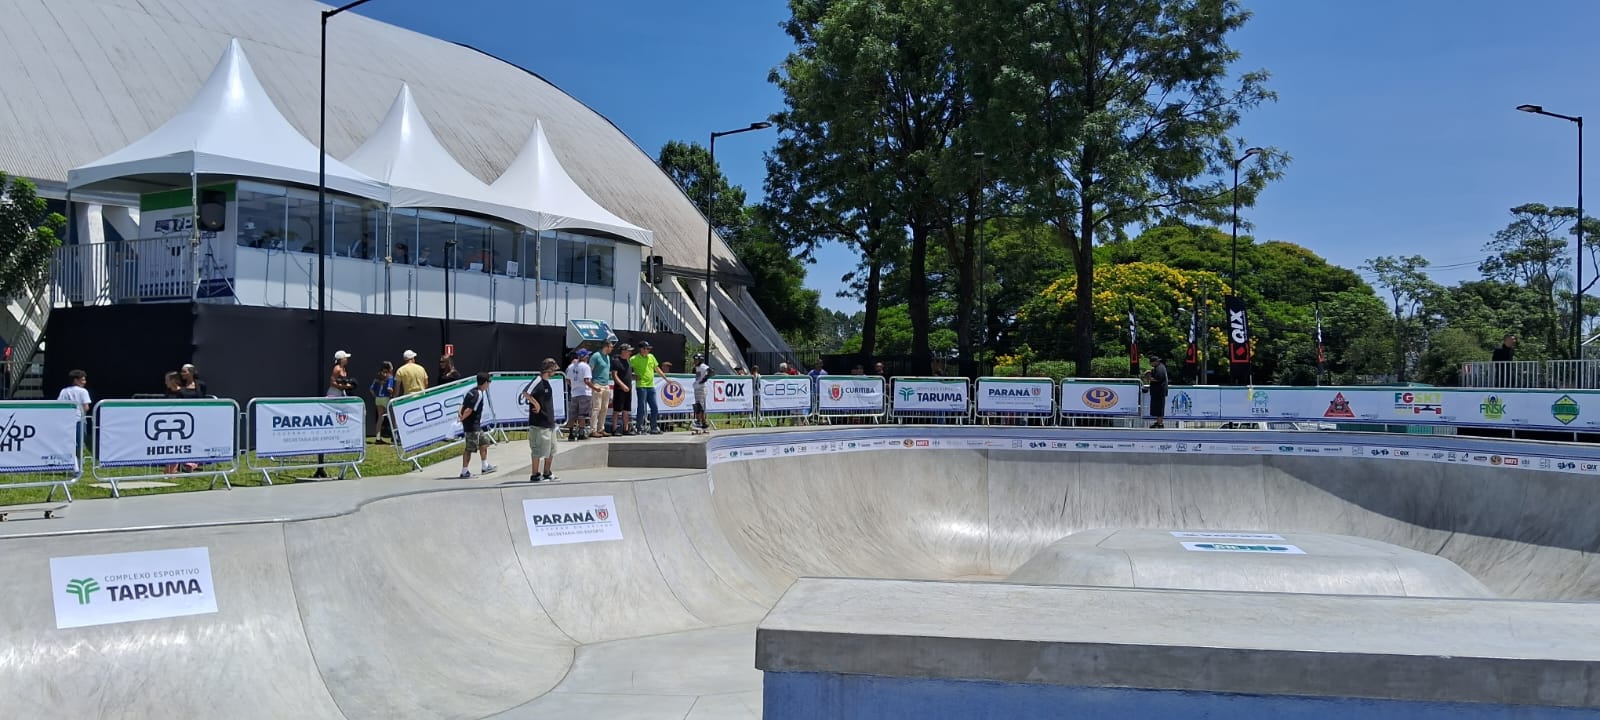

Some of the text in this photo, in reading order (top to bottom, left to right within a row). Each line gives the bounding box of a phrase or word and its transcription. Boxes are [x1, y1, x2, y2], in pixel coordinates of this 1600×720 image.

[1230, 309, 1245, 344] QIX
[725, 383, 745, 398] QIX
[917, 392, 963, 402] TARUMA
[989, 387, 1031, 397] PARANÁ
[402, 394, 465, 427] CBS
[272, 411, 334, 429] PARANÁ
[146, 445, 192, 456] HOCKS
[533, 509, 596, 525] PARANÁ
[104, 567, 200, 582] COMPLEXO ESPORTIVO
[106, 578, 203, 602] TARUMA
